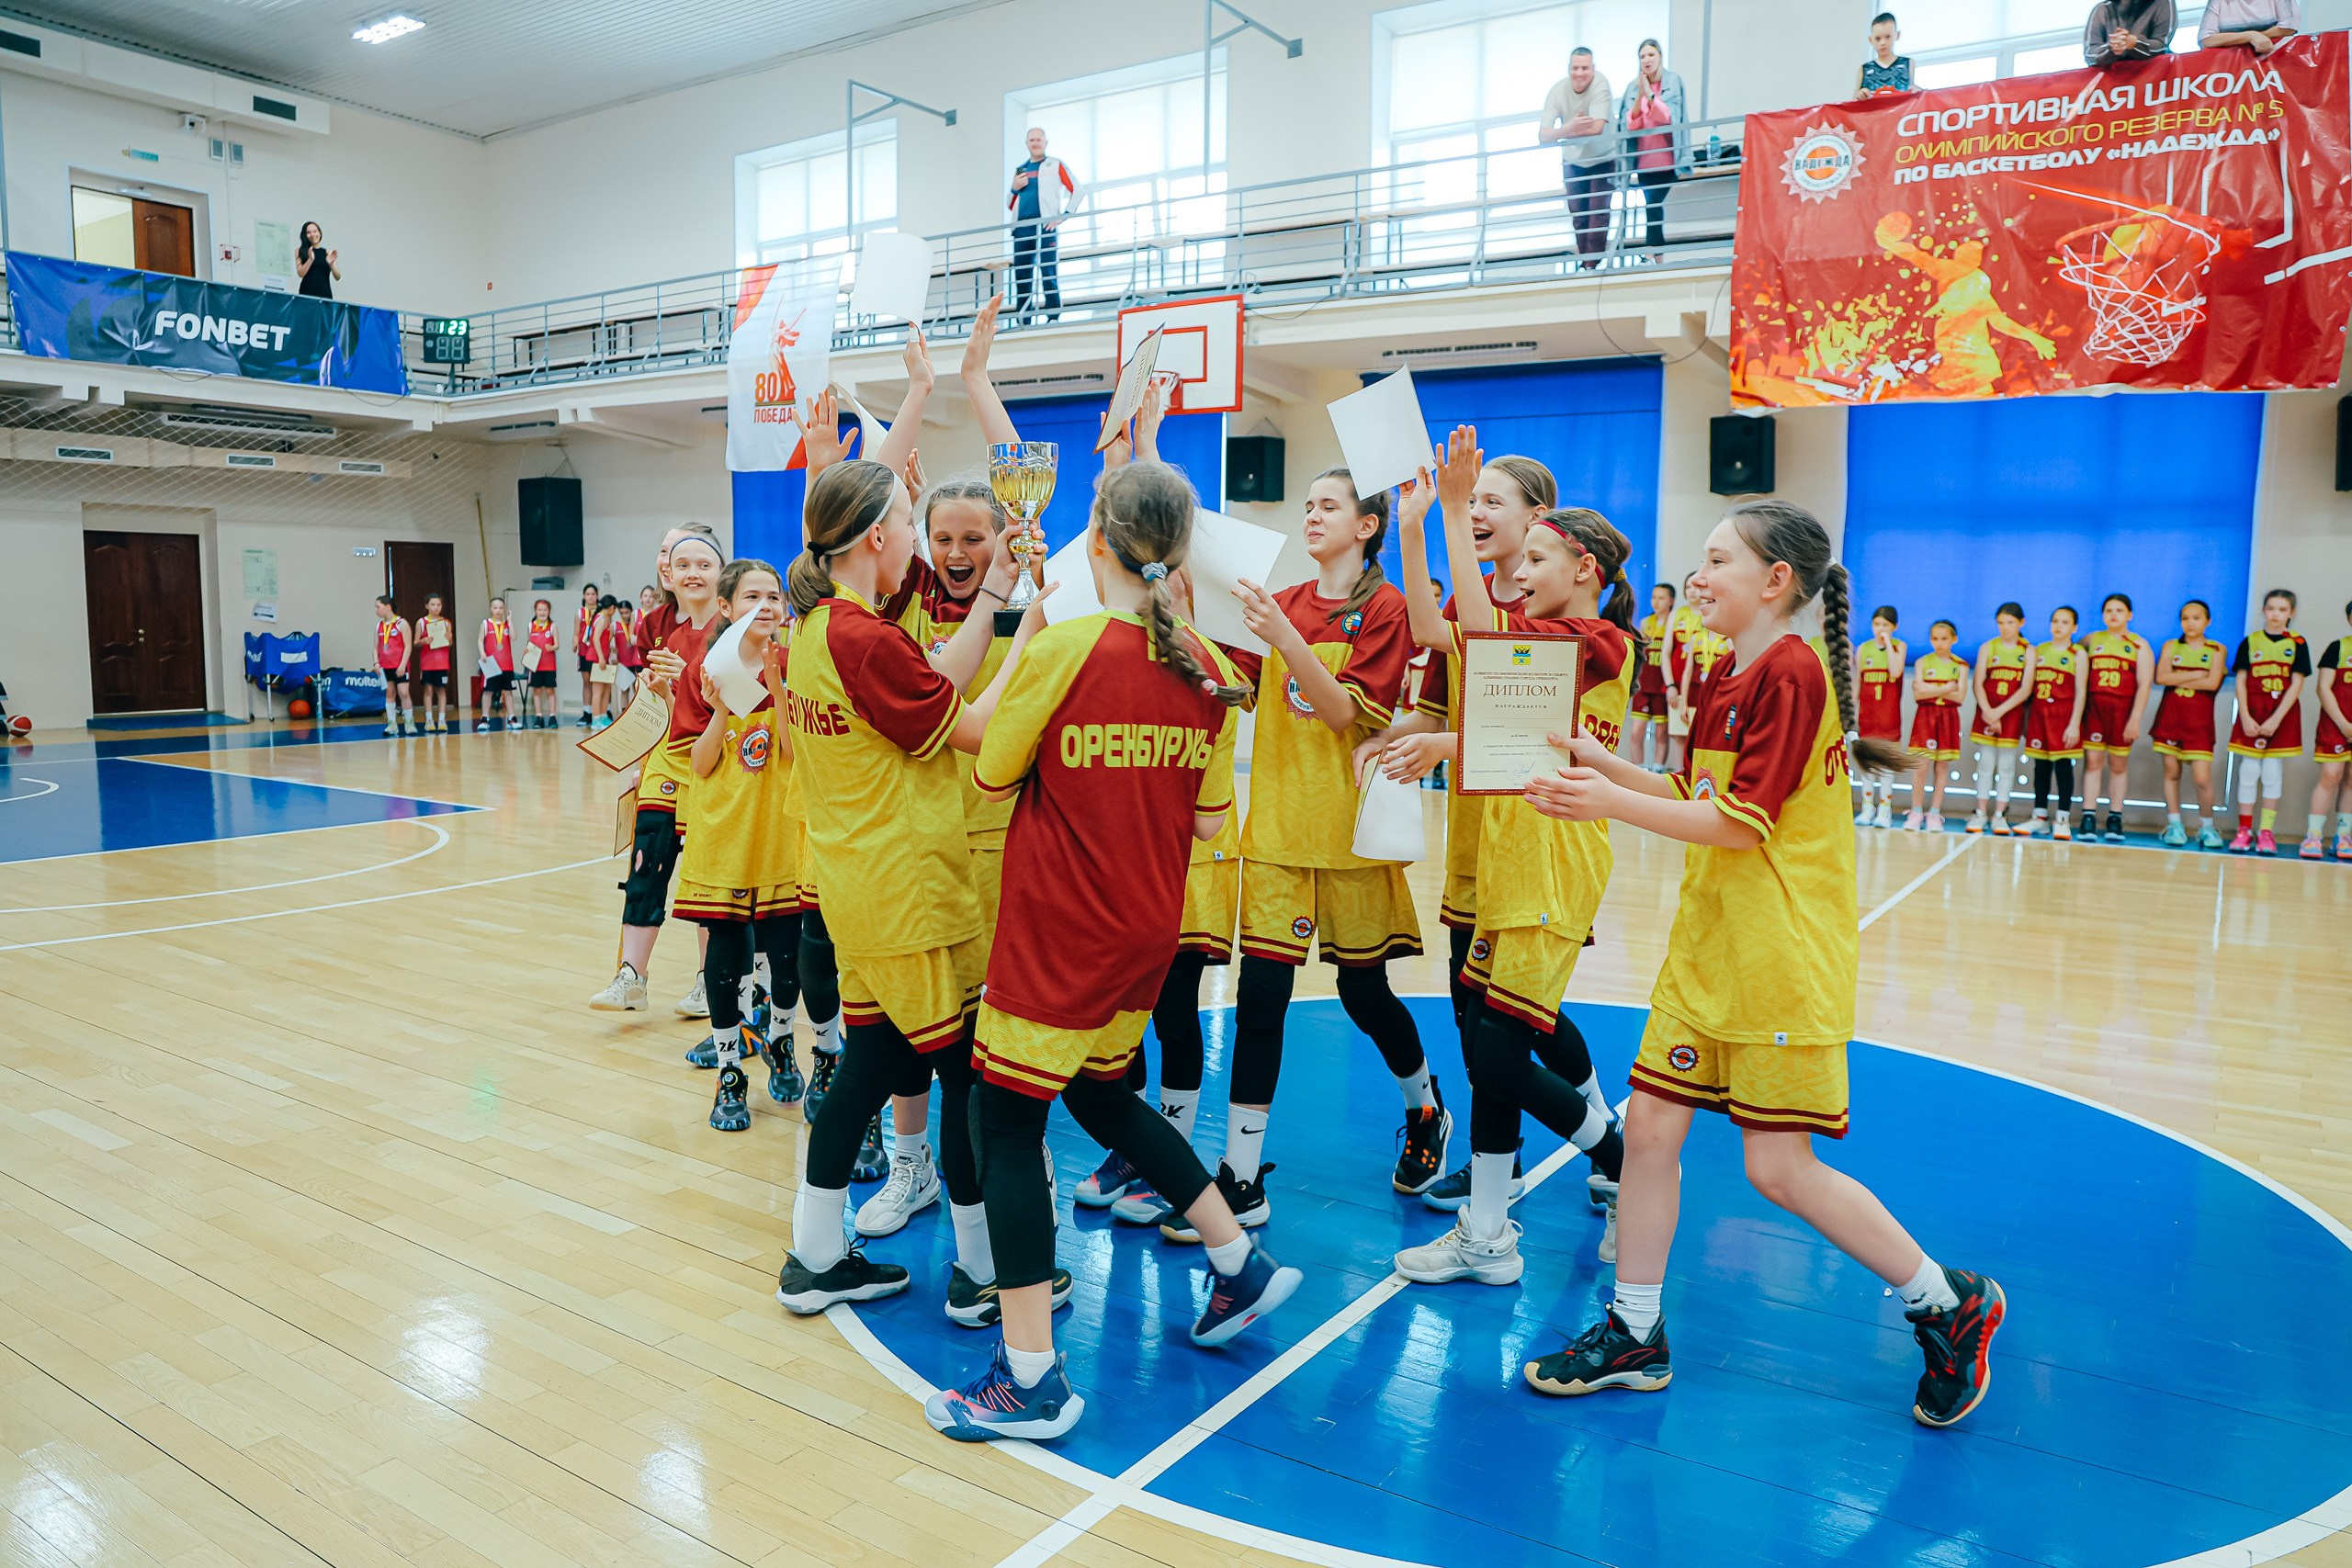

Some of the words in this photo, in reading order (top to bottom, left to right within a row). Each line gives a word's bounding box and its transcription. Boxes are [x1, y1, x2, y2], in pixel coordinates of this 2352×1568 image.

[1896, 85, 2135, 138] СПОРТИВНАЯ
[2143, 69, 2286, 107] ШКОЛА
[1894, 123, 2104, 164] ОЛИМПИЙСКОГО
[2109, 106, 2233, 139] РЕЗЕРВА
[2268, 98, 2284, 118] 5
[1894, 164, 1929, 186] ПО
[1931, 146, 2103, 180] БАСКЕТБОЛУ
[2106, 128, 2281, 161] «НАДЕЖДА»
[154, 309, 290, 352] FONBET
[754, 372, 777, 402] 80
[753, 407, 795, 424] ПОБЕДА
[1483, 684, 1557, 697] ДИПЛОМ
[635, 707, 662, 728] ДИПЛОМ
